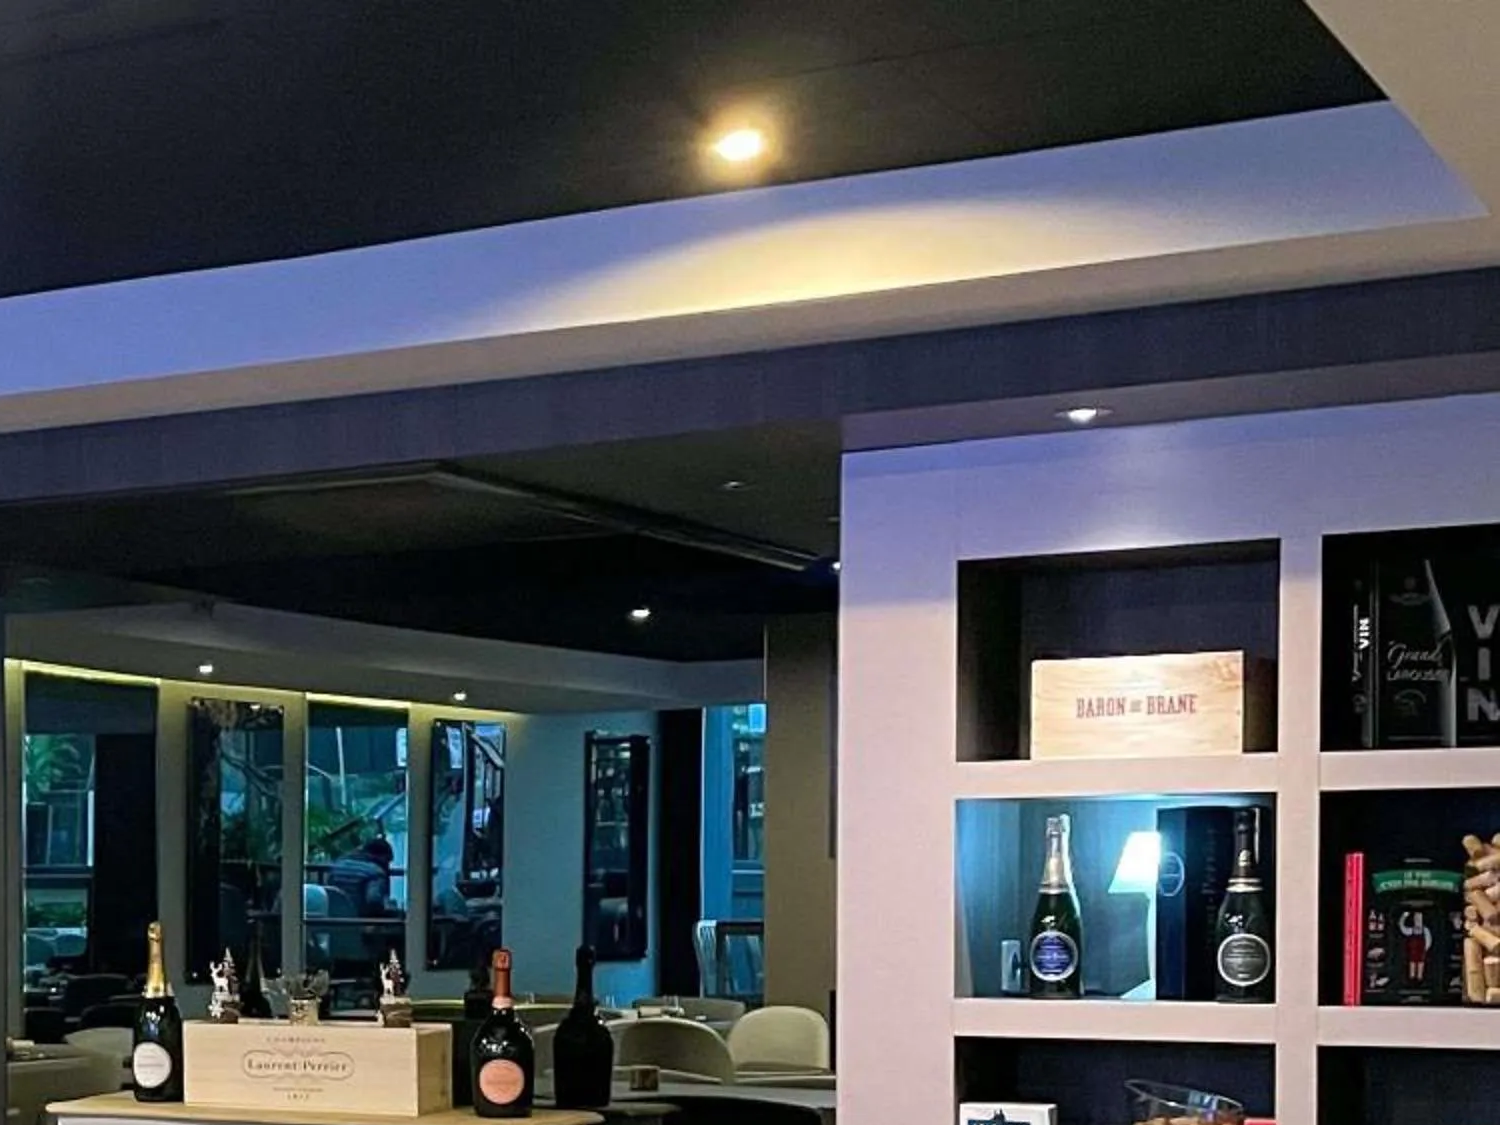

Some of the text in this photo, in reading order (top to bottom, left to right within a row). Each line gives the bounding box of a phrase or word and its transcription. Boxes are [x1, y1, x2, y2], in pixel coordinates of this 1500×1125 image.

[1359, 617, 1370, 649] VIN
[1076, 697, 1126, 718] BARON
[1146, 693, 1198, 715] BRANE
